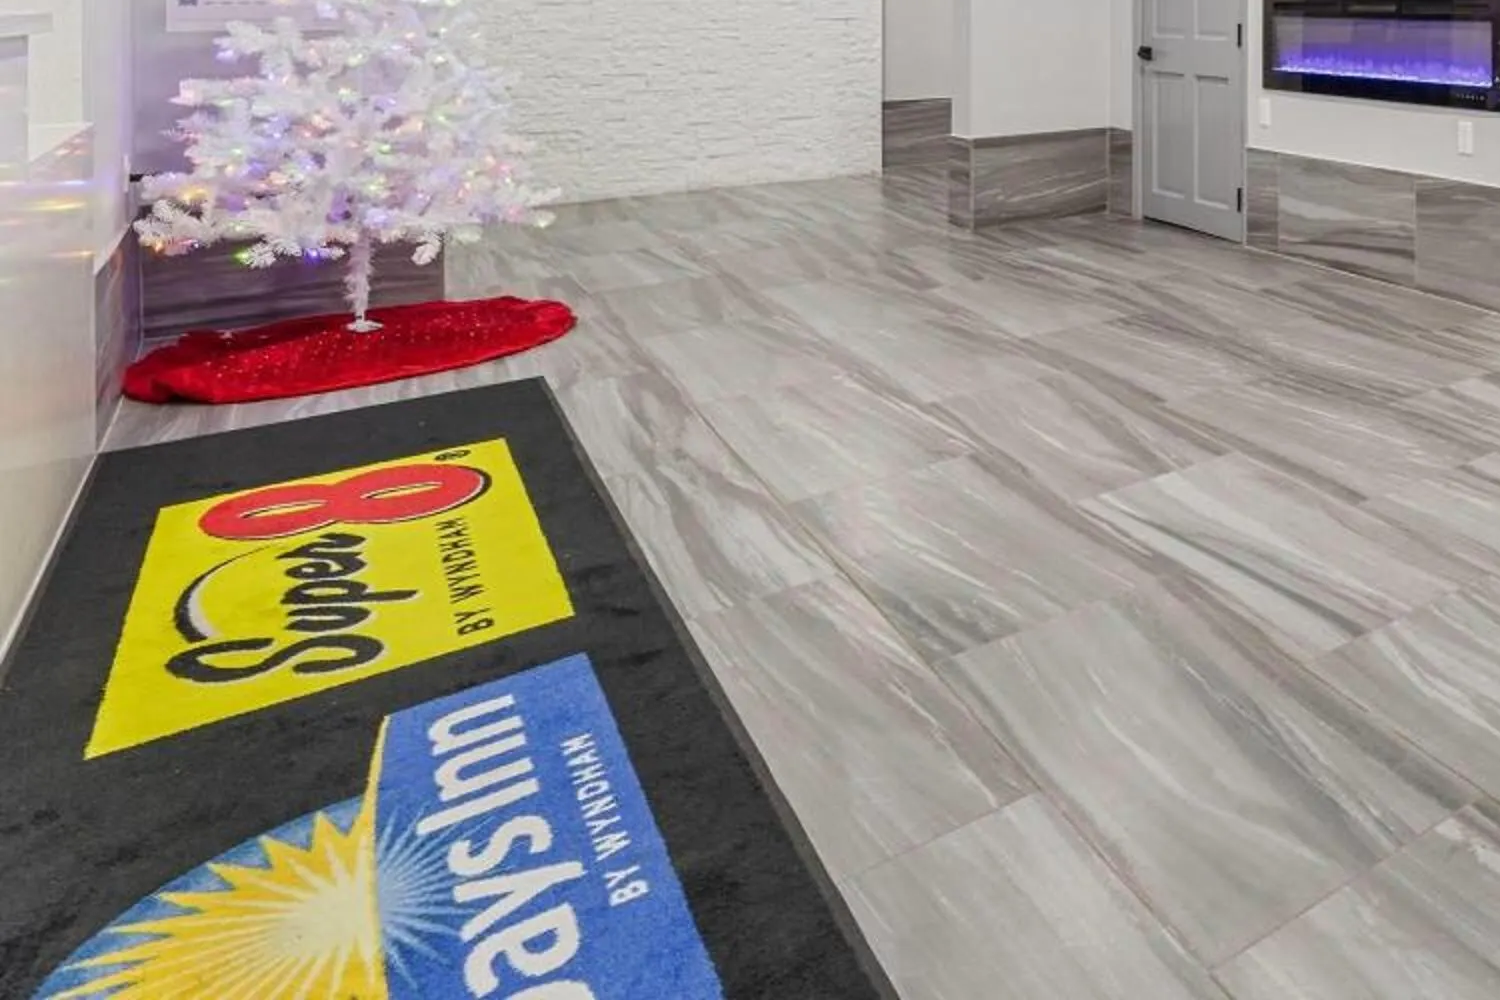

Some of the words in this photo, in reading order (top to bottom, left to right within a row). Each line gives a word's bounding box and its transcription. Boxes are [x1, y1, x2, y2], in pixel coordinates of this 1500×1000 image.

[198, 464, 492, 540] 8
[435, 516, 487, 605] WYNDHAM
[164, 533, 420, 684] Super
[454, 607, 495, 636] BY
[559, 732, 632, 862] WYNDHAM
[446, 815, 596, 1000] ays
[603, 864, 649, 907] BY
